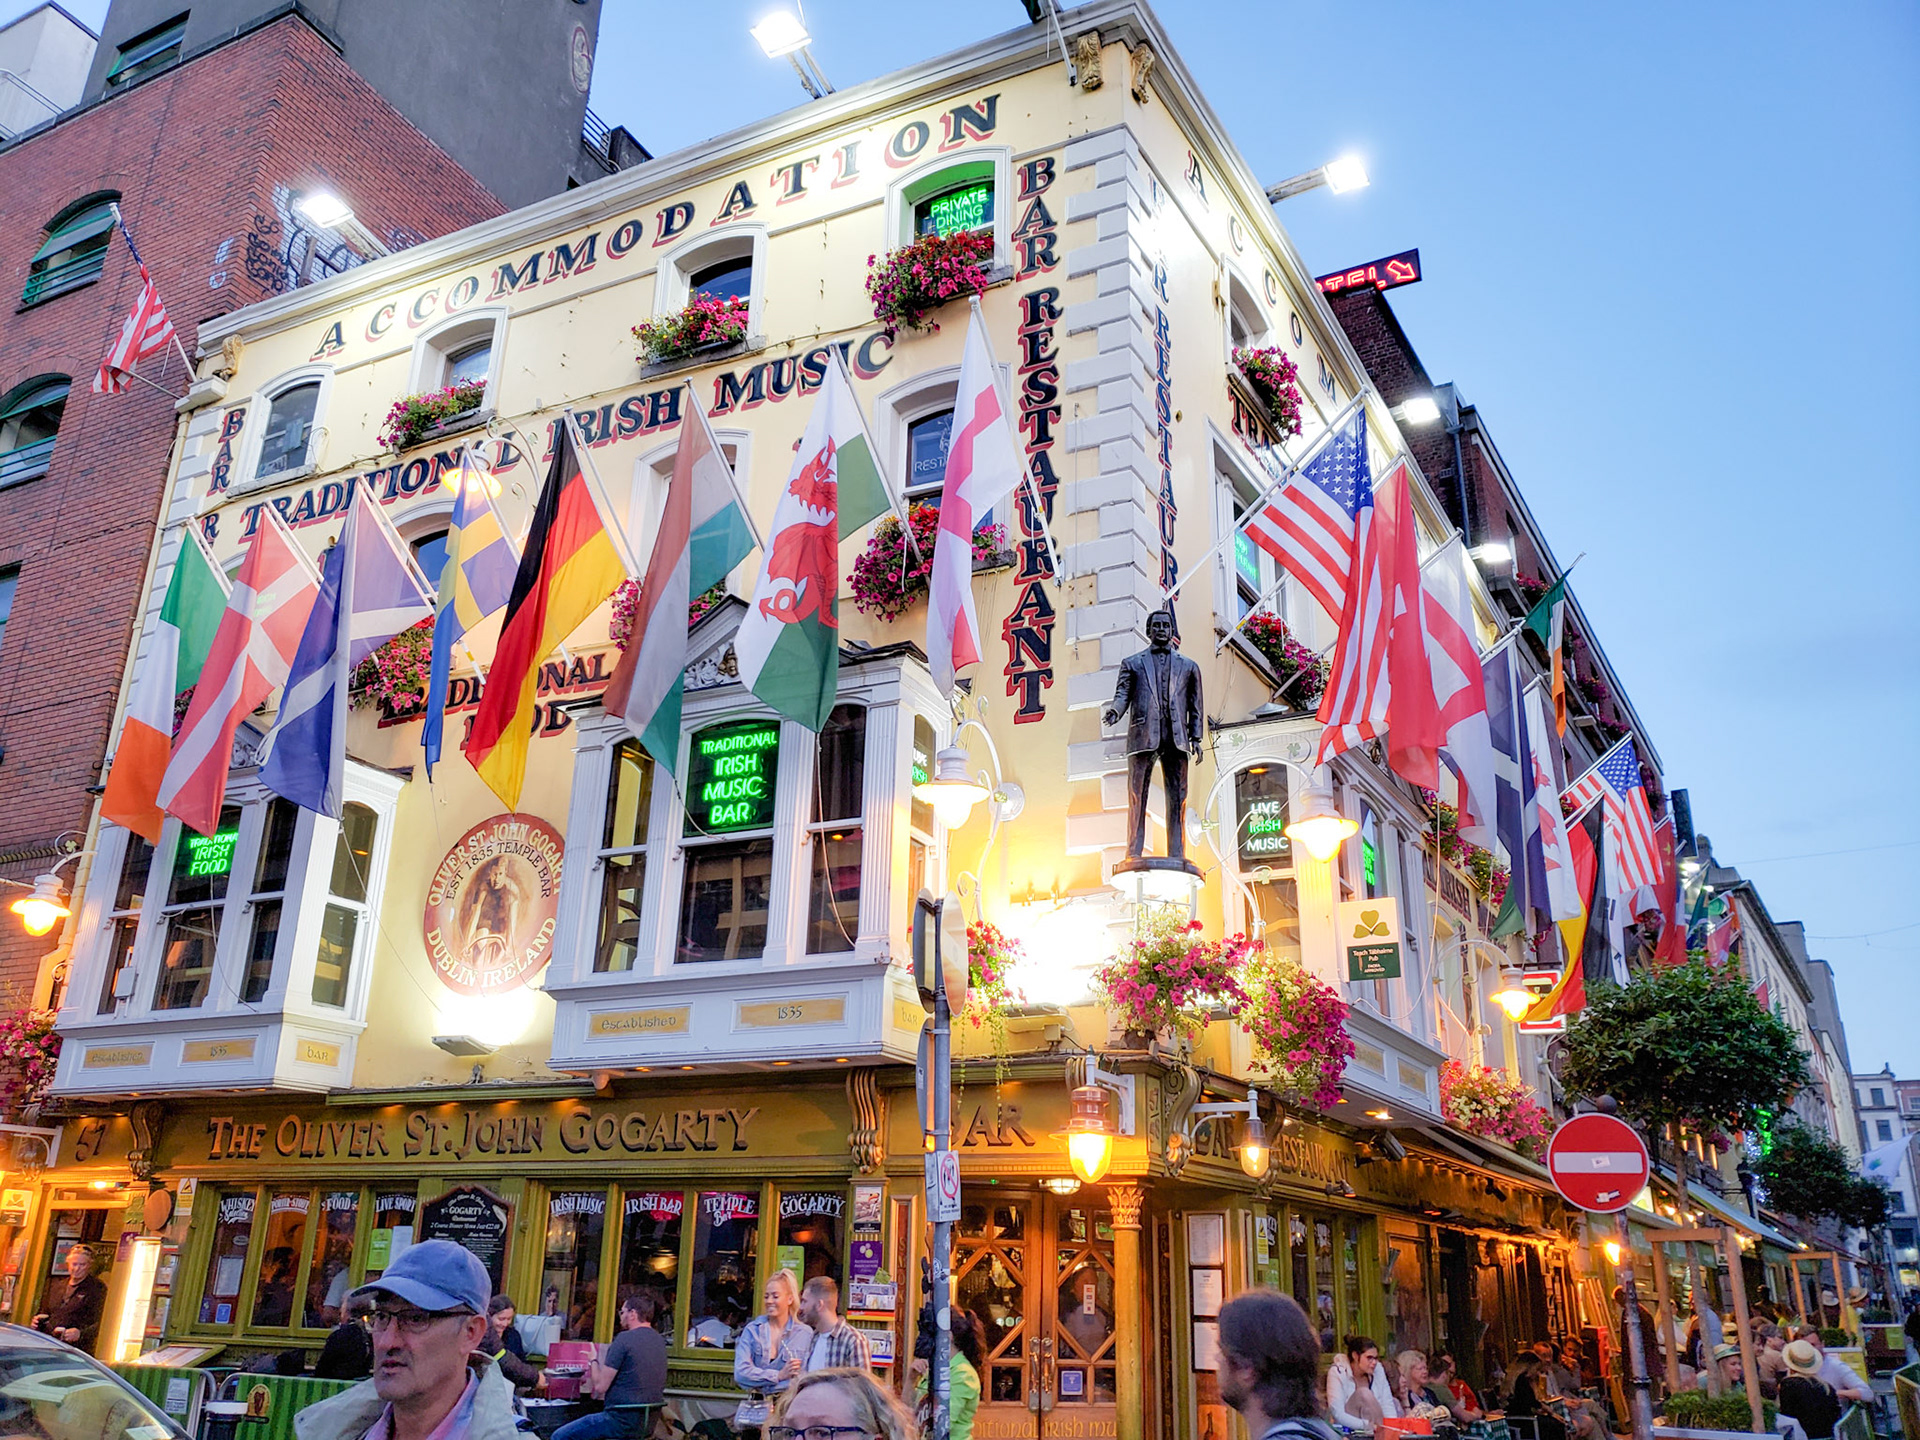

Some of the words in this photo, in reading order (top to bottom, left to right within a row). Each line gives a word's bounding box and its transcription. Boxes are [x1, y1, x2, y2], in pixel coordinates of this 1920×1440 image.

[931, 188, 988, 218] PRIVATE
[309, 93, 1002, 362] ACCOMMODATION
[936, 204, 984, 229] DINING
[1012, 156, 1062, 282] BAR
[202, 404, 246, 497] BAR
[238, 430, 523, 545] TRADITIONL
[1002, 284, 1063, 724] RESTAURANT
[701, 732, 777, 754] TRADITIONAL
[715, 753, 758, 776] IRISH
[703, 776, 763, 801] MUSIC
[710, 802, 750, 825] BAR
[1250, 800, 1281, 815] LIVE
[194, 844, 231, 861] IRISH
[1246, 836, 1290, 852] MUSIC
[190, 858, 228, 876] FOOD
[428, 846, 470, 907] OLIVER
[467, 829, 488, 854] ST
[490, 822, 530, 845] JOHN
[445, 870, 465, 900] EST
[465, 844, 494, 871] 1835
[497, 841, 543, 869] TEMPLE
[537, 865, 551, 899] BAR
[426, 926, 479, 988] DUBLIN
[481, 916, 557, 989] IRELAND
[776, 1005, 804, 1021] 1835
[206, 1115, 267, 1160] THE
[275, 1112, 391, 1159] OLIVER
[450, 1109, 547, 1161] JOHN
[560, 1105, 762, 1154] GOGARTY
[326, 1197, 351, 1211] FOOD
[375, 1198, 394, 1213] LIVE
[394, 1197, 417, 1213] SPORT
[449, 1206, 483, 1216] GOGARTY
[550, 1196, 576, 1215] IRISH
[576, 1195, 606, 1215] MUSIC
[625, 1196, 658, 1215] IRISH
[659, 1195, 683, 1216] BAR
[703, 1196, 756, 1215] TEMPLE
[780, 1195, 846, 1216] GOGARTY
[713, 1210, 732, 1227] Bar
